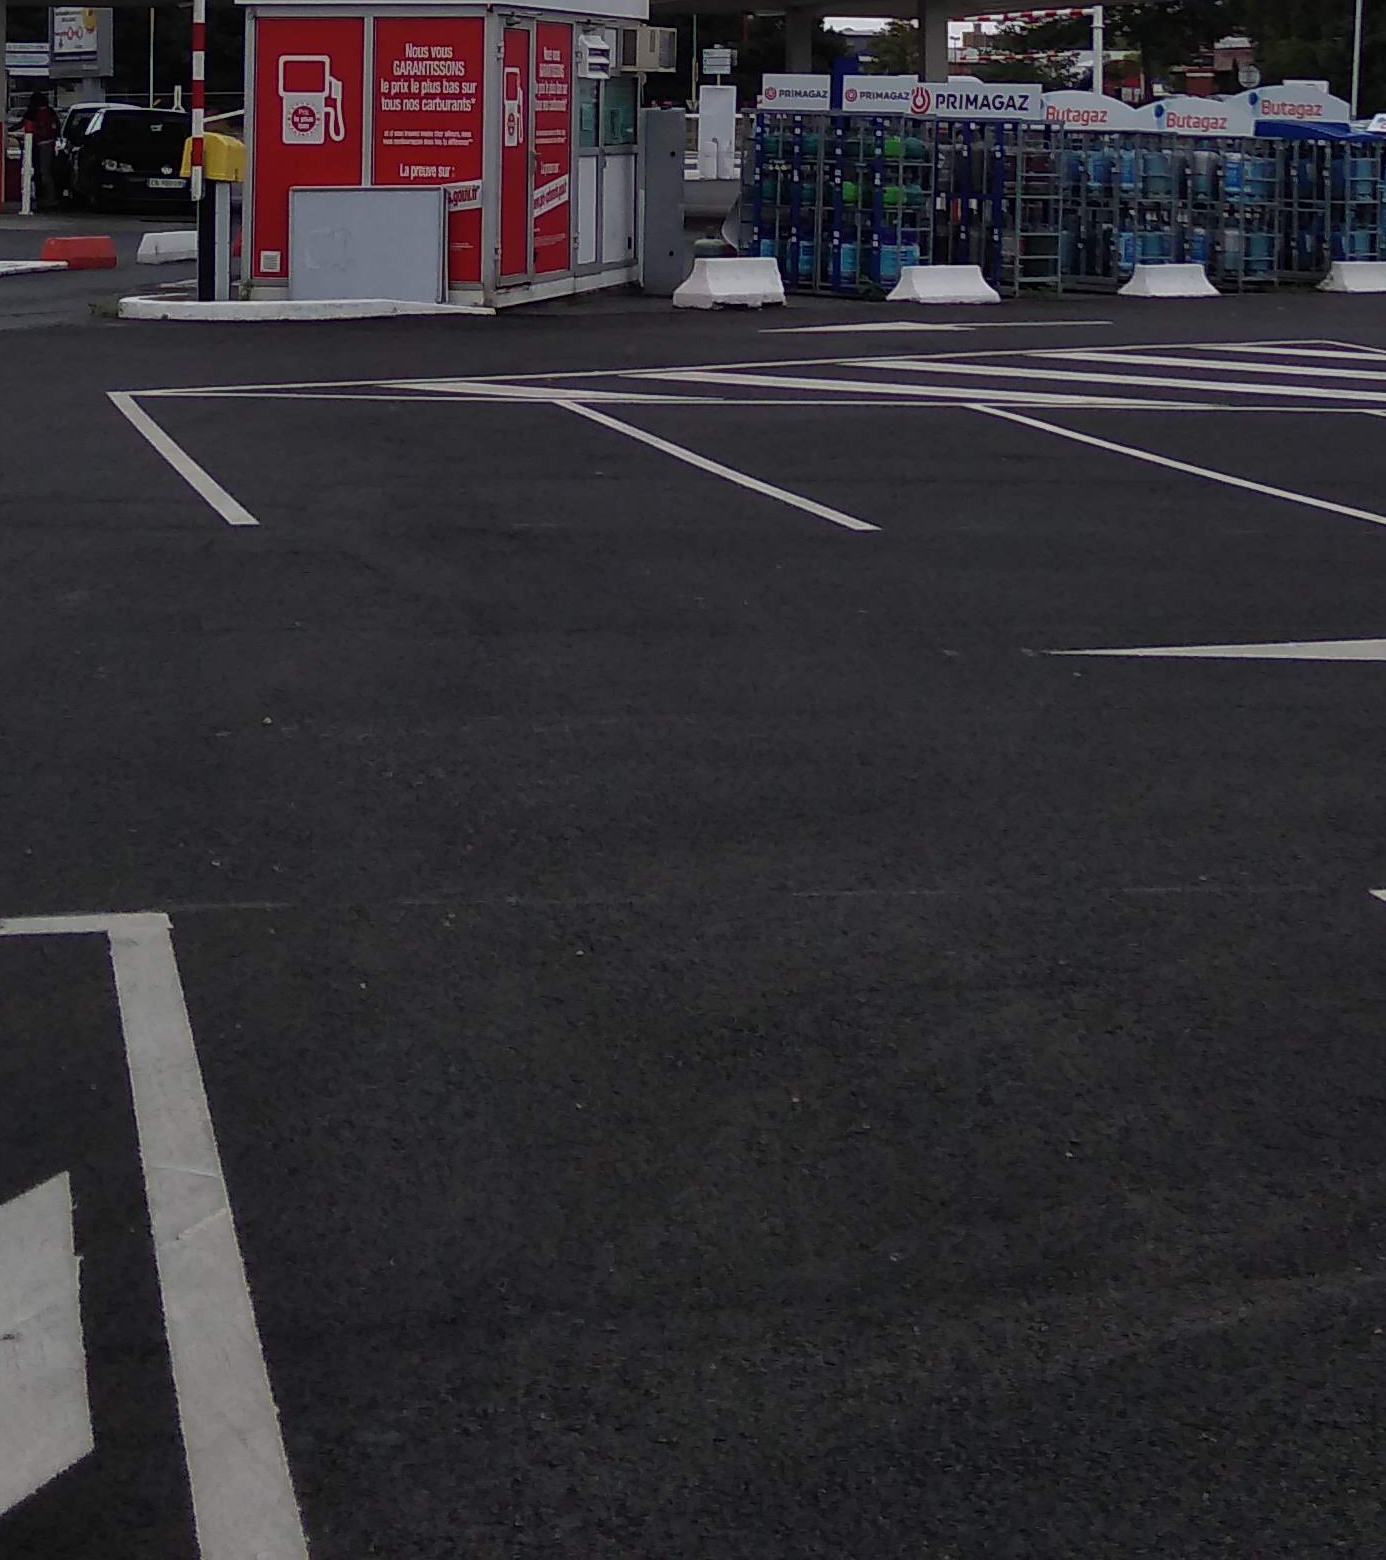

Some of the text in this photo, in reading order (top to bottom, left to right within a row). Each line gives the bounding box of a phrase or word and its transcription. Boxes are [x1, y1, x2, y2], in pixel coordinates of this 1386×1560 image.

[405, 43, 453, 58] Nous vous
[393, 60, 465, 76] GARANTISSONS
[380, 78, 477, 96] le prix le plus bas sur
[778, 89, 828, 99] PRIMAGAZ
[381, 96, 401, 111] tous
[403, 99, 420, 111] nos
[859, 91, 910, 101] PRIMAGAZ
[935, 93, 1029, 111] PRIMAGAZ
[1046, 105, 1108, 126] Butagaz
[1261, 100, 1323, 120] Butagaz
[1166, 112, 1228, 132] Butagaz
[399, 163, 409, 177] La
